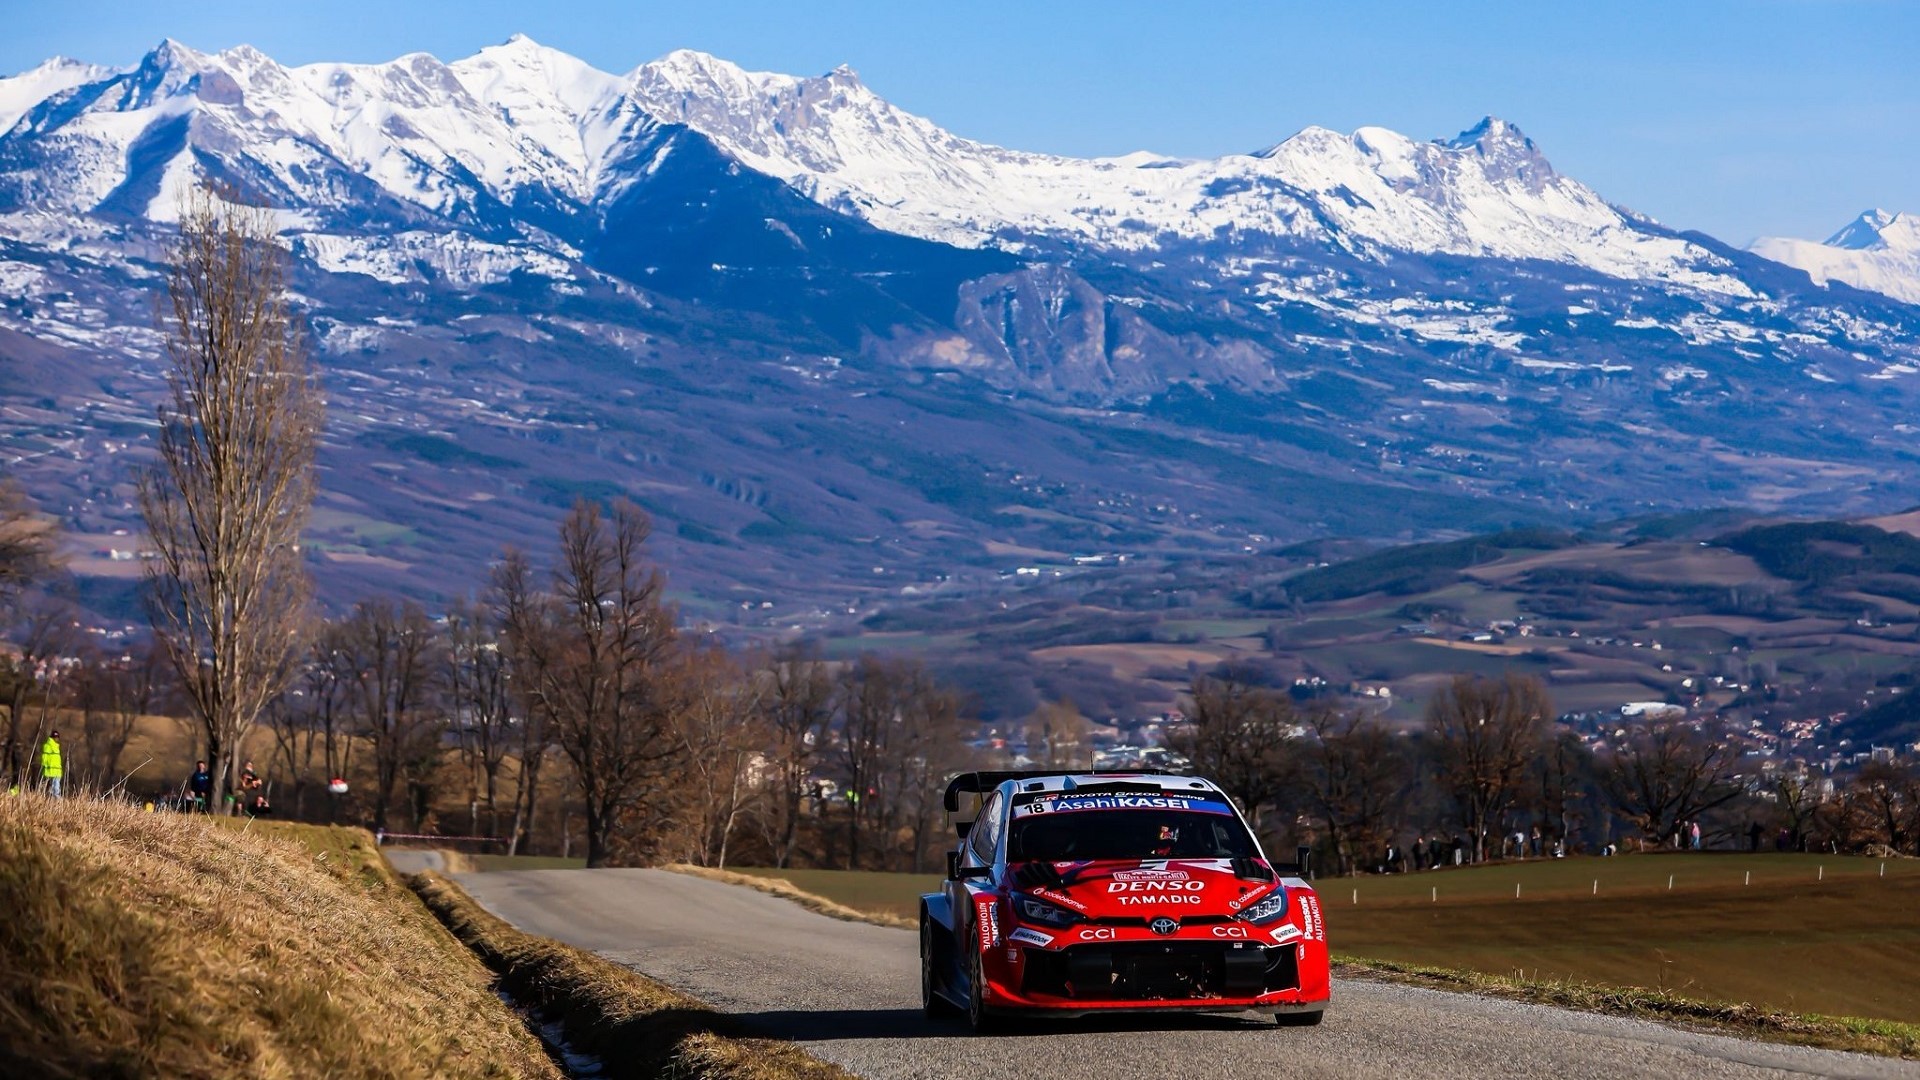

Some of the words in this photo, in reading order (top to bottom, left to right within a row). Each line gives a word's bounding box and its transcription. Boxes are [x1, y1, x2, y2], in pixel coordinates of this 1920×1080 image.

[1024, 803, 1045, 814] 18
[1107, 880, 1205, 893] DENSO
[1117, 895, 1201, 905] TAMADIC
[1298, 895, 1314, 940] Panasonic
[979, 902, 991, 950] AUTOMOTIVE
